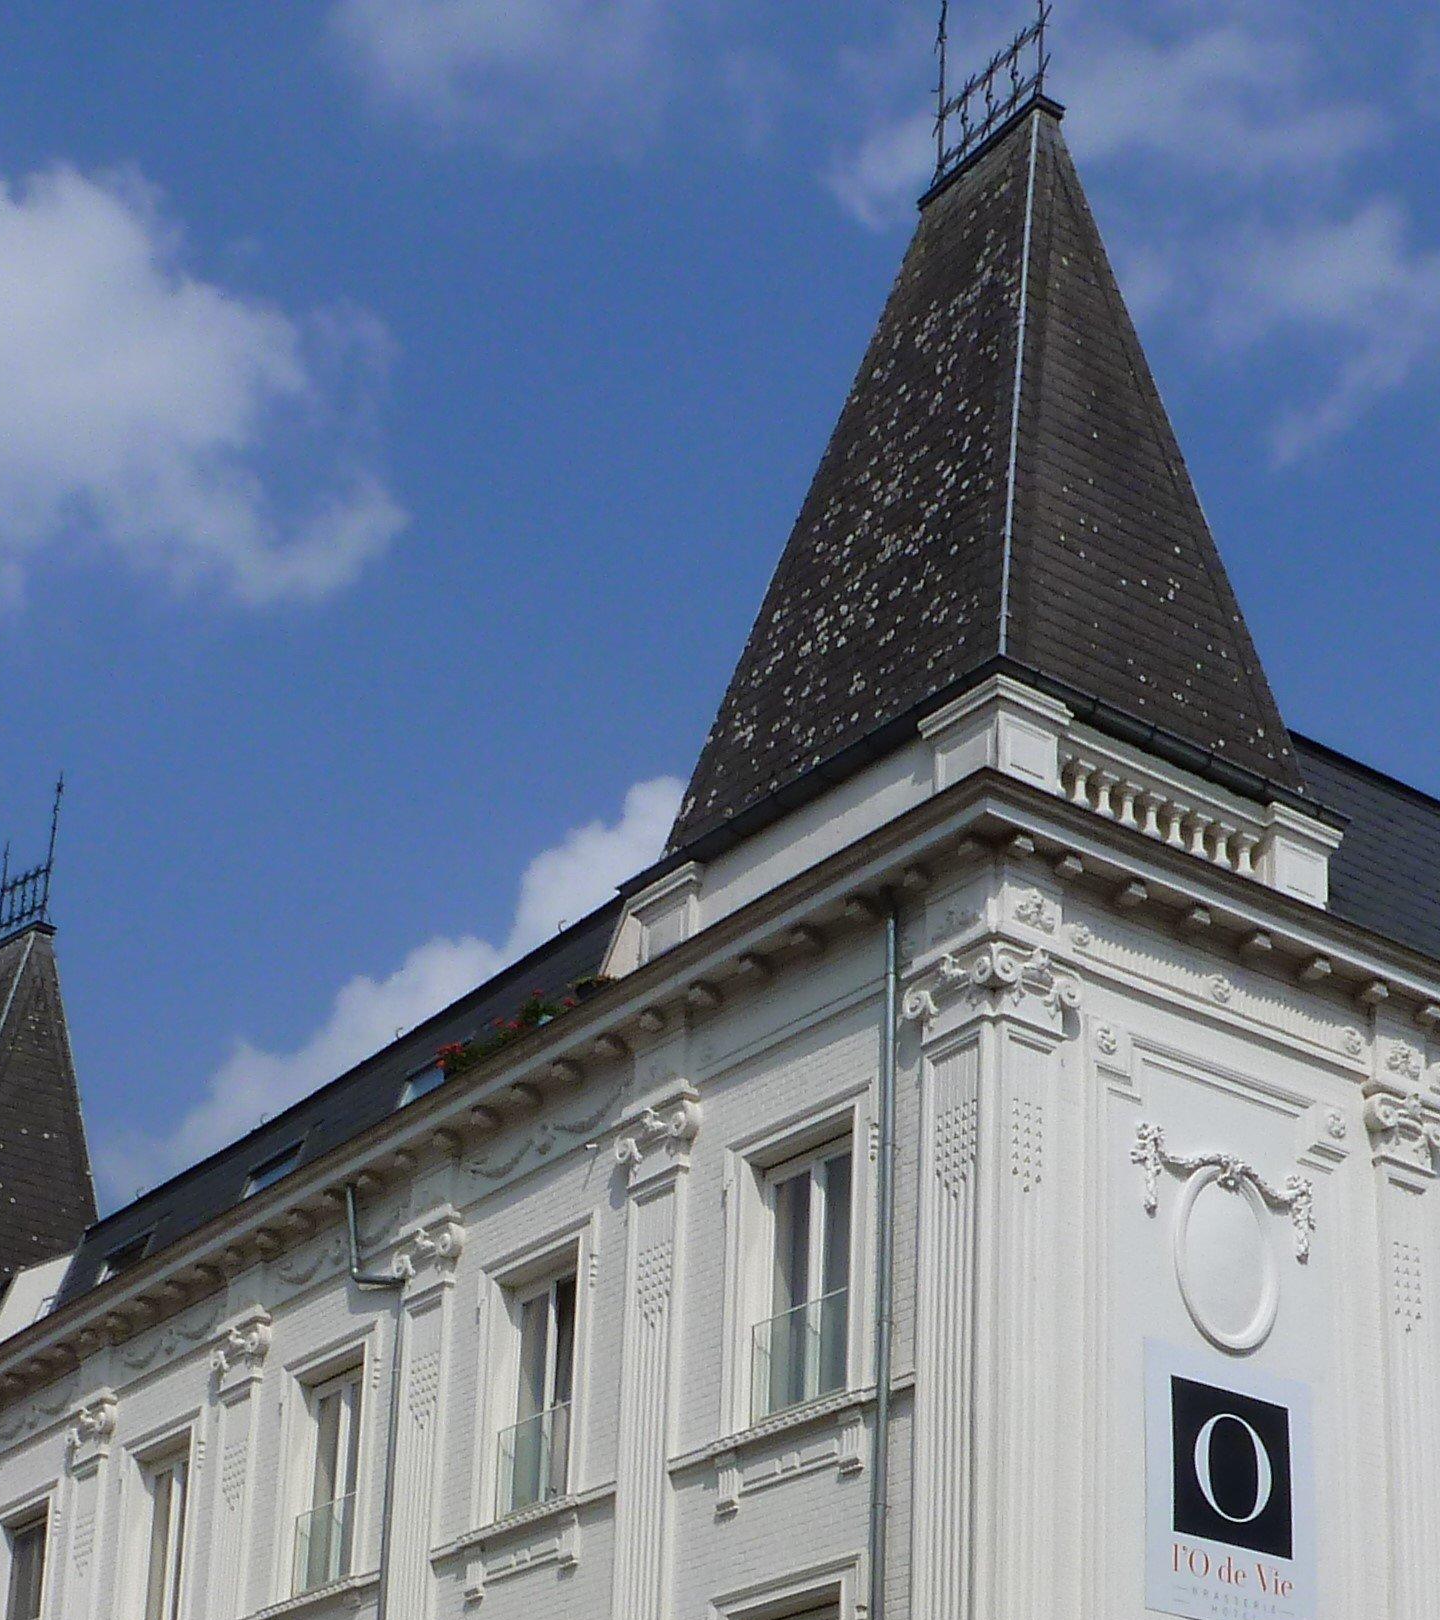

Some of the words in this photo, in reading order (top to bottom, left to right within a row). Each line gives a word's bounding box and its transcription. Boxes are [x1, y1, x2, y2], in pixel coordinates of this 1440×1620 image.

[1194, 1413, 1272, 1523] O
[1217, 1556, 1247, 1587] de
[1255, 1563, 1294, 1597] Vie
[1191, 1587, 1276, 1615] BRASSERIE
